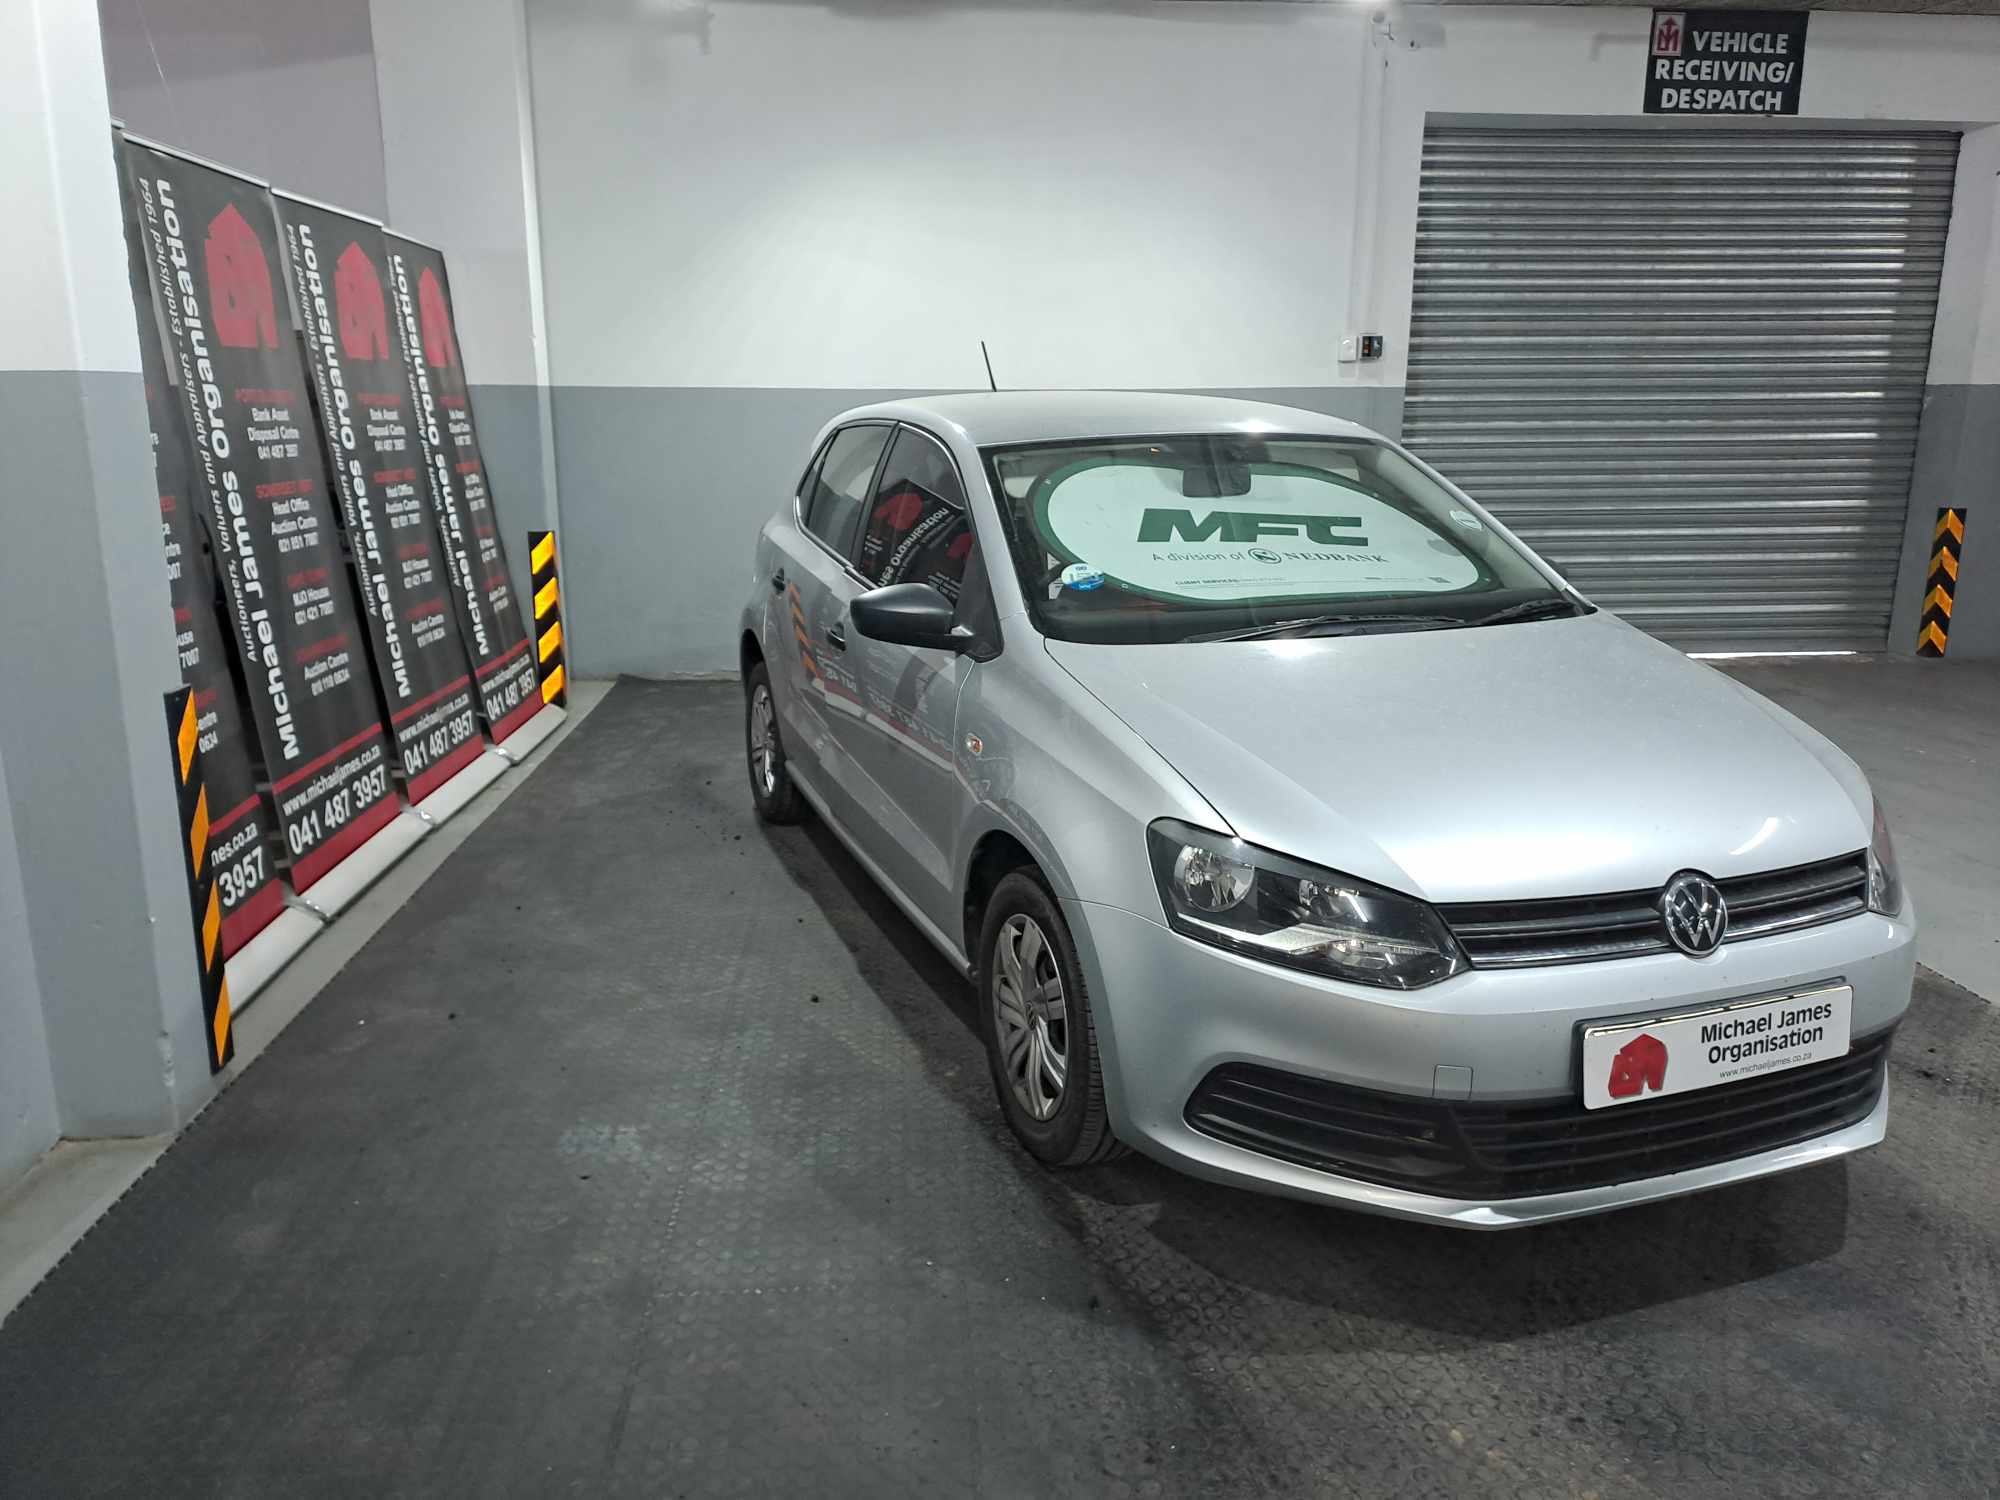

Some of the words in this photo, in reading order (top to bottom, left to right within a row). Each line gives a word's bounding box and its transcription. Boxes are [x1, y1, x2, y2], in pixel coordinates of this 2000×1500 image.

[1655, 58, 1795, 84] RECEIVING/
[1692, 31, 1789, 55] VEHICLE
[1660, 87, 1783, 112] DESPATCH
[139, 177, 159, 224] 1964
[150, 228, 183, 336] Established
[156, 179, 230, 459] Organisation
[299, 224, 356, 450] Organisation
[393, 254, 440, 446] Organisation
[180, 352, 208, 448] Appraisers
[200, 450, 217, 485] and
[435, 453, 463, 543] James
[210, 489, 232, 553] Valuers
[222, 470, 263, 599] James
[349, 459, 382, 565] James
[1137, 508, 1369, 547] MFC
[1152, 553, 1163, 562] A
[1167, 551, 1226, 562] division
[1228, 551, 1246, 561] of
[1284, 552, 1390, 564] NEDBANK
[372, 573, 412, 698] Michael
[455, 549, 490, 656] Michael
[251, 609, 300, 760] Michael
[404, 740, 428, 775] 041
[430, 726, 449, 757] 487
[449, 709, 473, 744] 3957
[289, 809, 322, 855] 041
[324, 788, 350, 829] 487
[352, 764, 386, 809] 3957
[219, 845, 265, 907] 3957
[1700, 1012, 1773, 1044] Michael
[1777, 1002, 1832, 1029] James
[1708, 1026, 1824, 1064] Organisation
